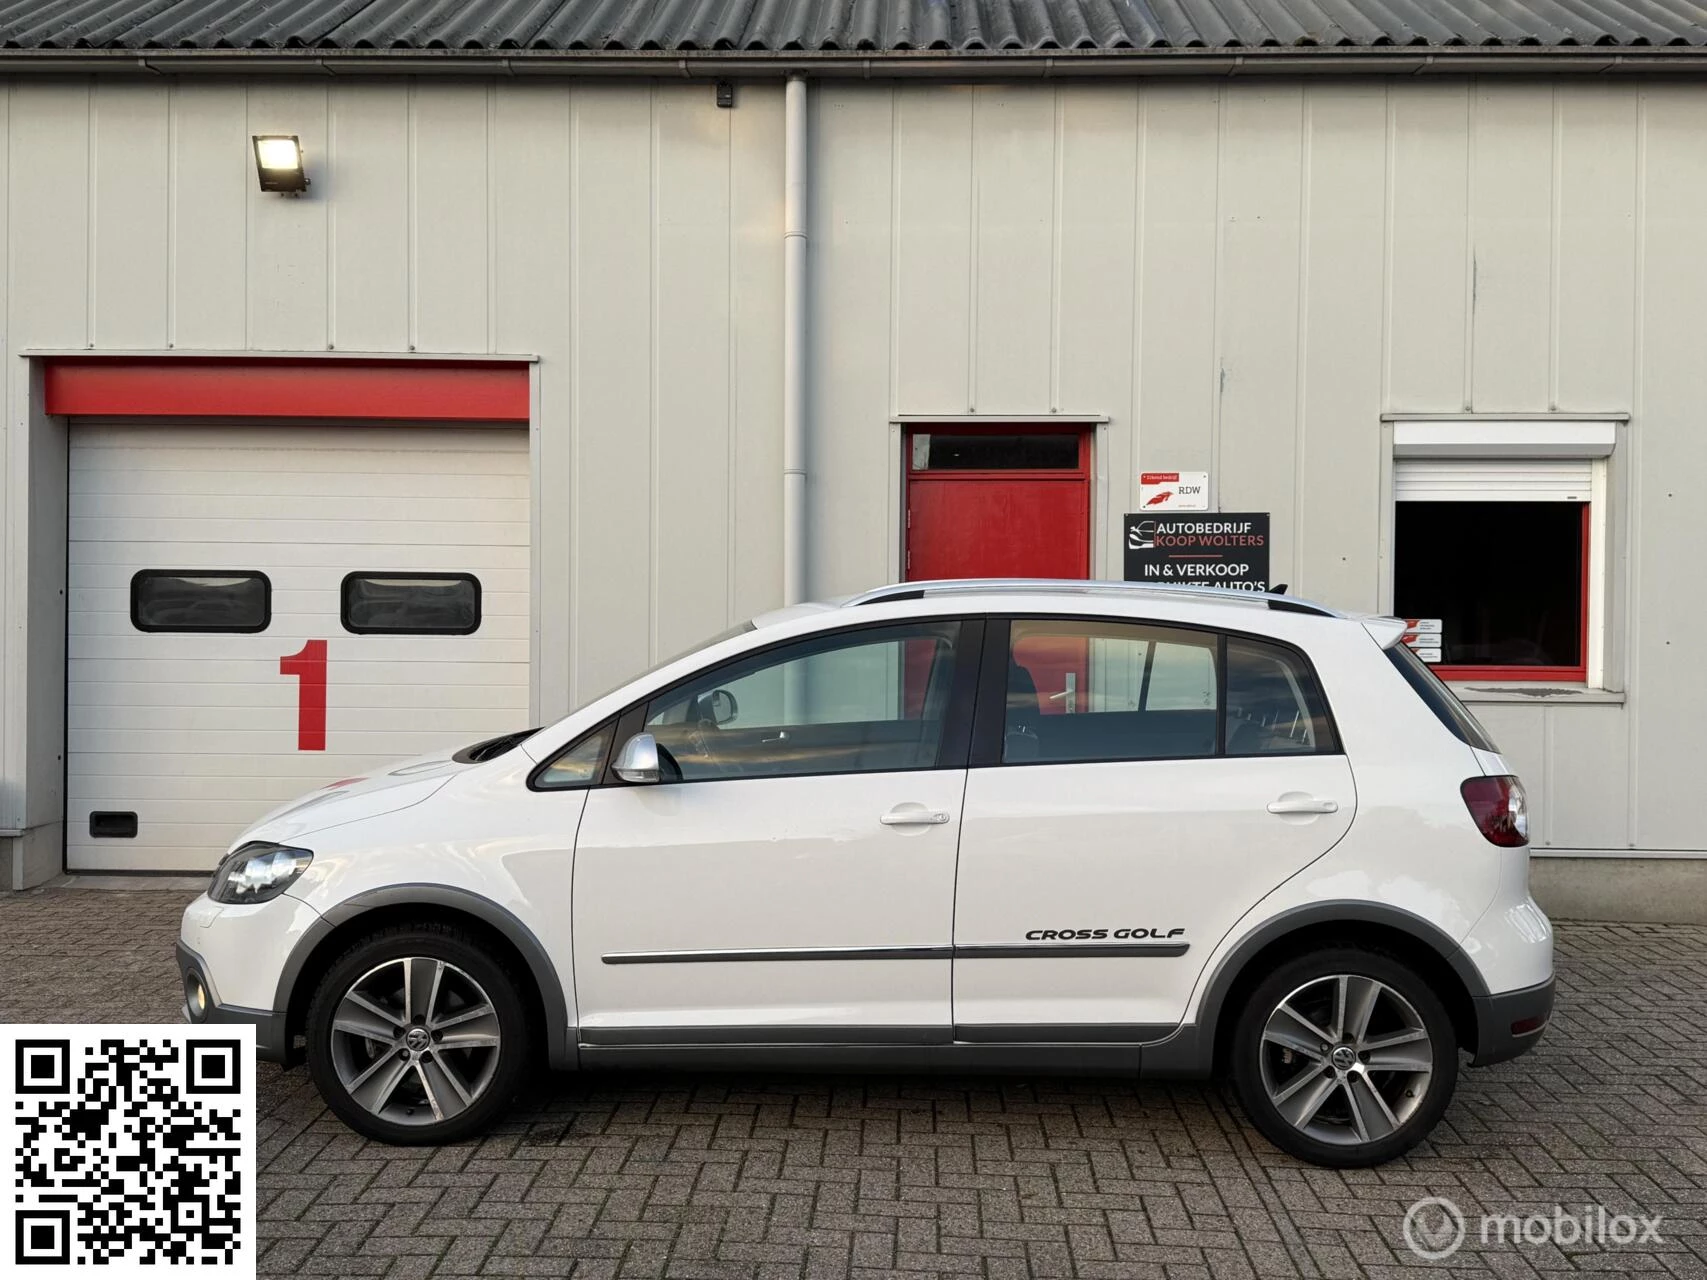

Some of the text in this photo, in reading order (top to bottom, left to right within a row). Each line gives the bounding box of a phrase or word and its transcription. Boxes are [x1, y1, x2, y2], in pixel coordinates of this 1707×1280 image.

[1178, 486, 1201, 495] RDW
[1156, 522, 1252, 534] AUTOBEDRIJF
[1156, 535, 1265, 547] KOOP WOLTERS
[1144, 563, 1249, 576] IN & VERKOOP
[280, 639, 327, 750] 1
[1025, 928, 1185, 940] CROSS GOLF
